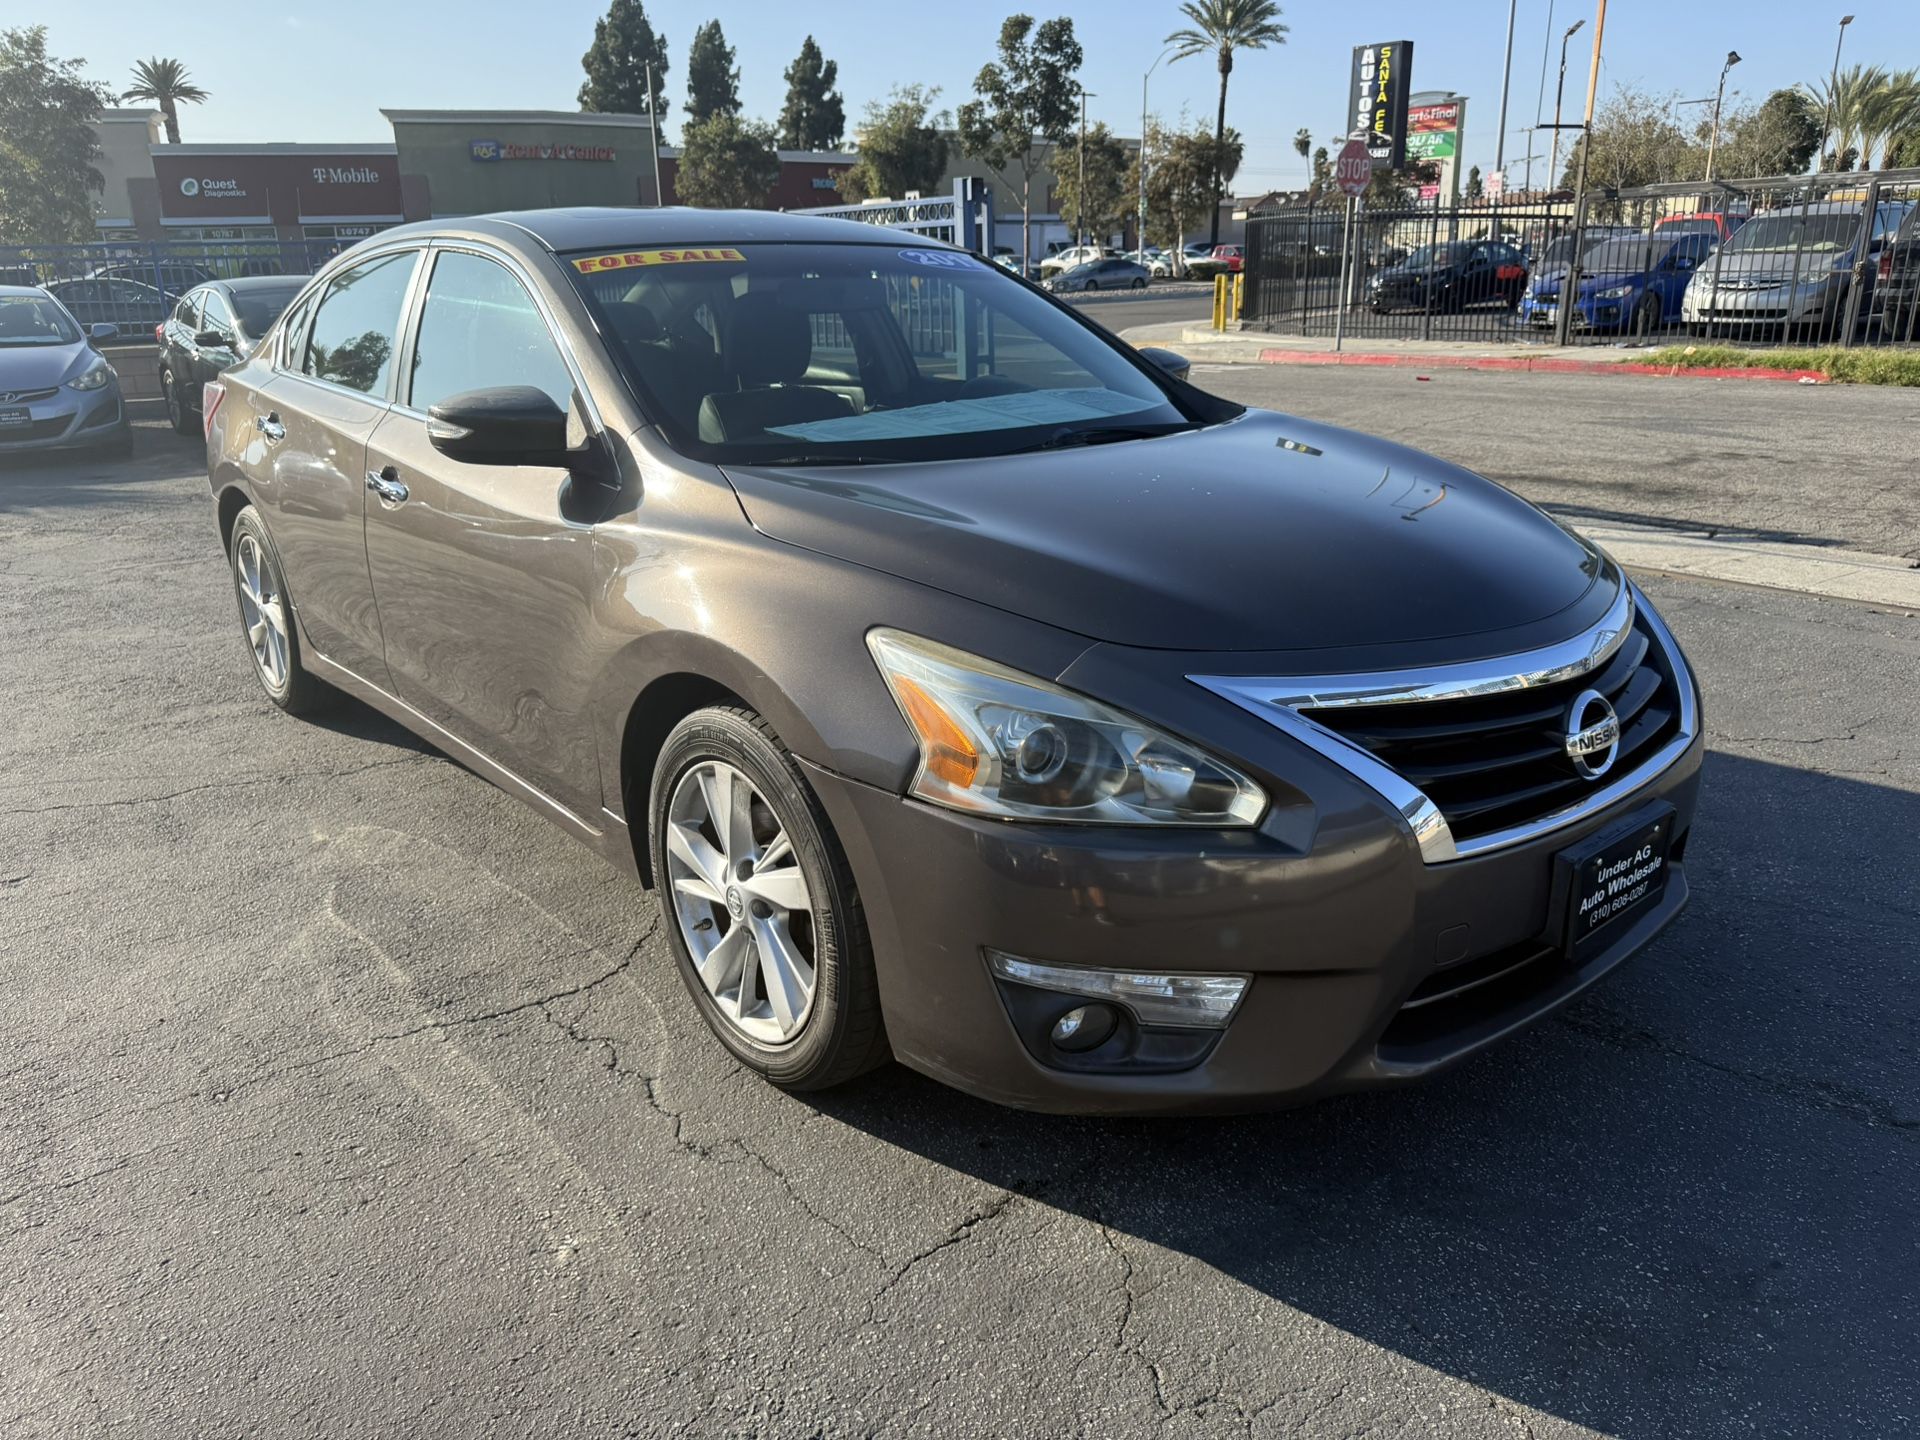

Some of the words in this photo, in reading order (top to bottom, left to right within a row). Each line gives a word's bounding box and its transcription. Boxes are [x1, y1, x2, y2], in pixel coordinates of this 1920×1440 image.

[1376, 46, 1392, 103] SANTA
[1357, 48, 1376, 130] AUTOS
[1407, 133, 1444, 147] OLLAR
[473, 146, 497, 158] RAC
[1338, 157, 1370, 180] STOP
[202, 178, 237, 190] Quest
[204, 189, 247, 199] Diagnostics
[341, 227, 370, 236] 10747
[577, 253, 645, 273] FOR
[658, 248, 739, 264] SALE
[906, 250, 975, 268] 201
[1597, 856, 1632, 884] Under
[1634, 844, 1652, 864] AG
[1579, 890, 1605, 915] Auto
[1608, 856, 1662, 896] Wholesale
[1589, 902, 1611, 928] (310)
